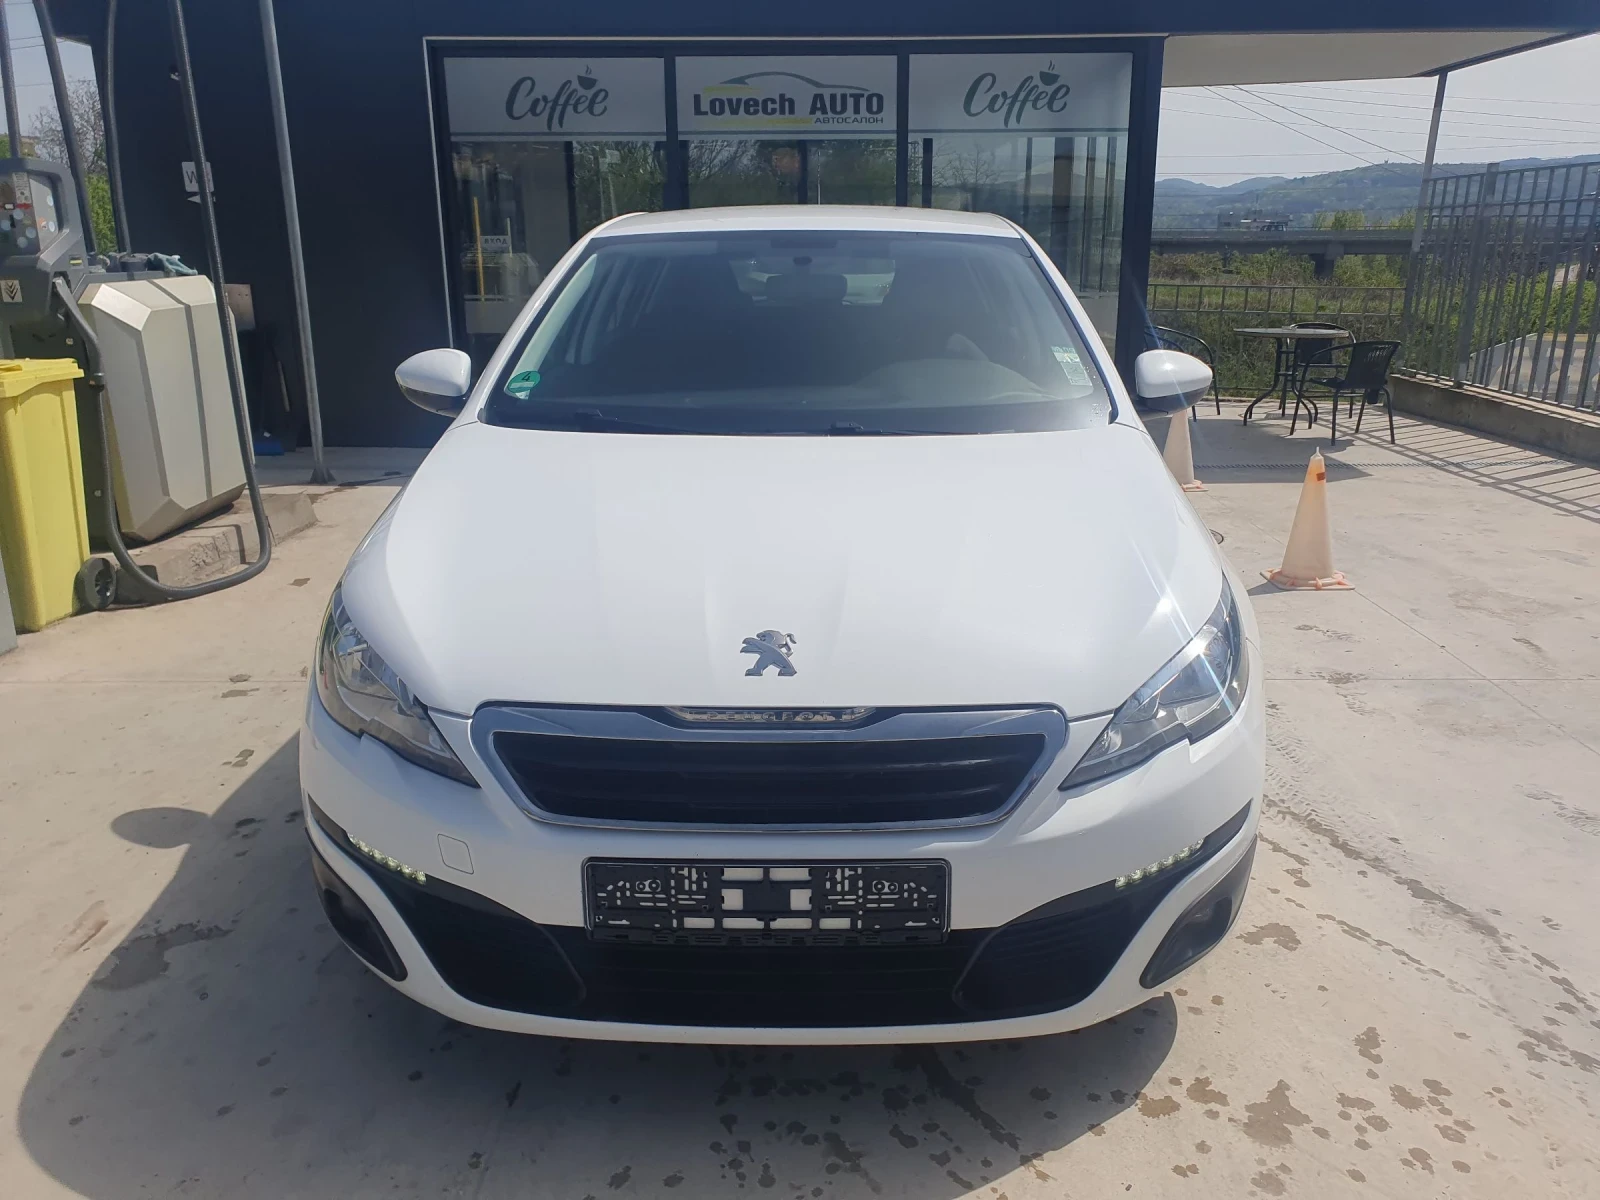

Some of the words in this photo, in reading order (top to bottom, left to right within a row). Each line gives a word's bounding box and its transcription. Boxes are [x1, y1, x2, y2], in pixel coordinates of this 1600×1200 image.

[505, 76, 609, 131] Coffee
[693, 93, 796, 116] Lovech
[809, 92, 884, 116] AUTO
[963, 72, 1071, 128] Coffee
[814, 116, 884, 124] АВТОСАЛОН
[521, 371, 531, 382] 4
